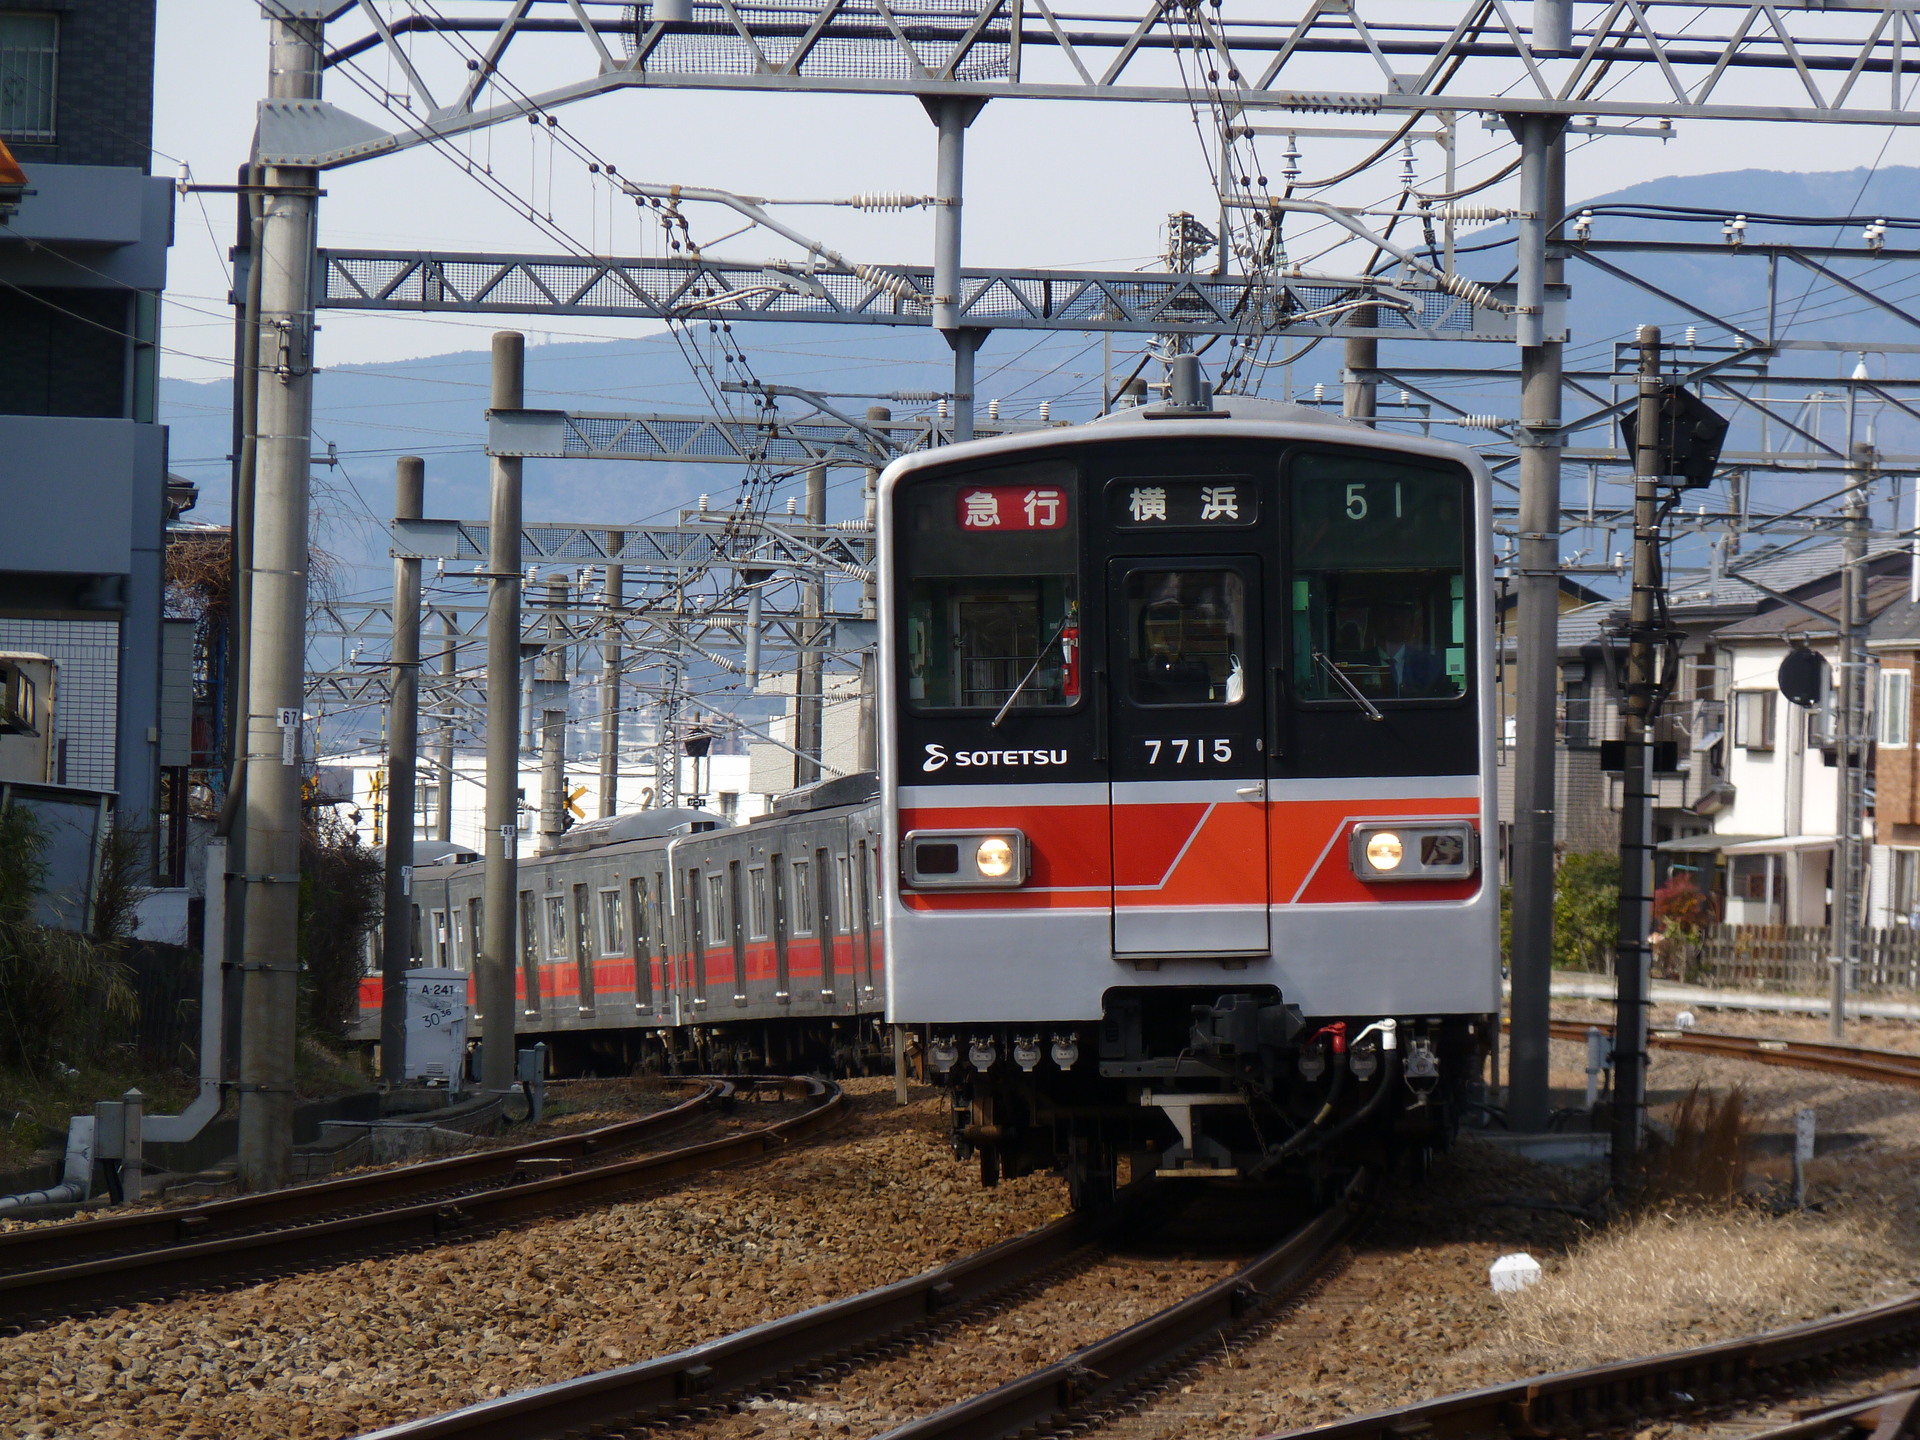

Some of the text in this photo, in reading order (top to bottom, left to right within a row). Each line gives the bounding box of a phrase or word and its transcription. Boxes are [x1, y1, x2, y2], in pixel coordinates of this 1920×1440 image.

[964, 489, 1060, 527] 急行
[1128, 486, 1239, 521] 横浜
[283, 710, 297, 725] 67
[955, 749, 1068, 767] SOTETSU
[1144, 739, 1232, 764] 7715
[503, 826, 513, 835] 69
